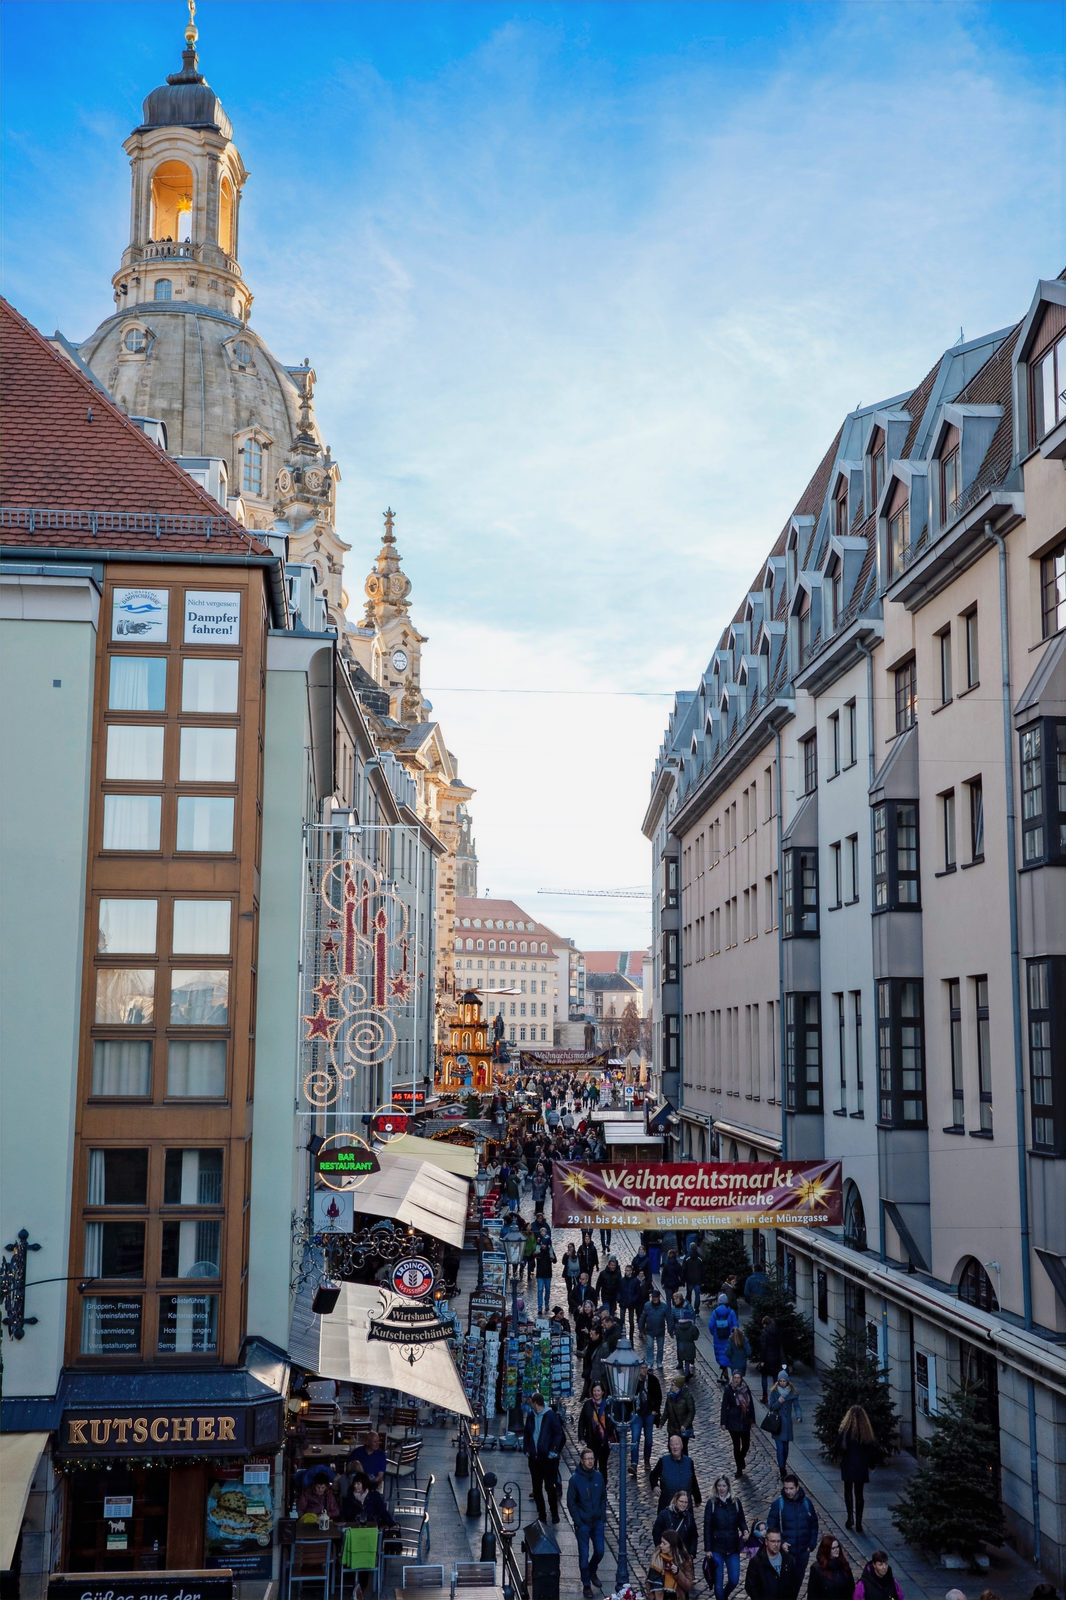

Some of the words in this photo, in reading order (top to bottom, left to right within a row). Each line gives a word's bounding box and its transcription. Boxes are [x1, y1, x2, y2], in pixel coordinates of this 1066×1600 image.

[188, 611, 239, 625] Dampfer
[192, 624, 233, 635] fahren!
[534, 1051, 594, 1060] Weihnachtsmarkt
[337, 1153, 355, 1161] BAR
[319, 1162, 373, 1171] RESTAURANT
[600, 1167, 794, 1191] Weihnachtsmarkt
[621, 1196, 641, 1207] an
[645, 1192, 670, 1207] der
[675, 1190, 774, 1207] Frauenkirche
[567, 1215, 594, 1224] 29.11.
[595, 1215, 610, 1224] bis
[611, 1215, 641, 1225] 24.12.
[656, 1215, 689, 1227] täglich
[691, 1215, 731, 1227] geöffnet
[746, 1214, 756, 1224] in
[758, 1213, 774, 1224] der
[776, 1212, 829, 1224] Münzgasse
[396, 1262, 430, 1277] ERDINGER
[391, 1310, 434, 1320] Wirtshaus
[372, 1325, 453, 1341] Kutscherschänke
[158, 1342, 216, 1350] Sempr-Katen
[68, 1416, 237, 1445] KUTSCHER
